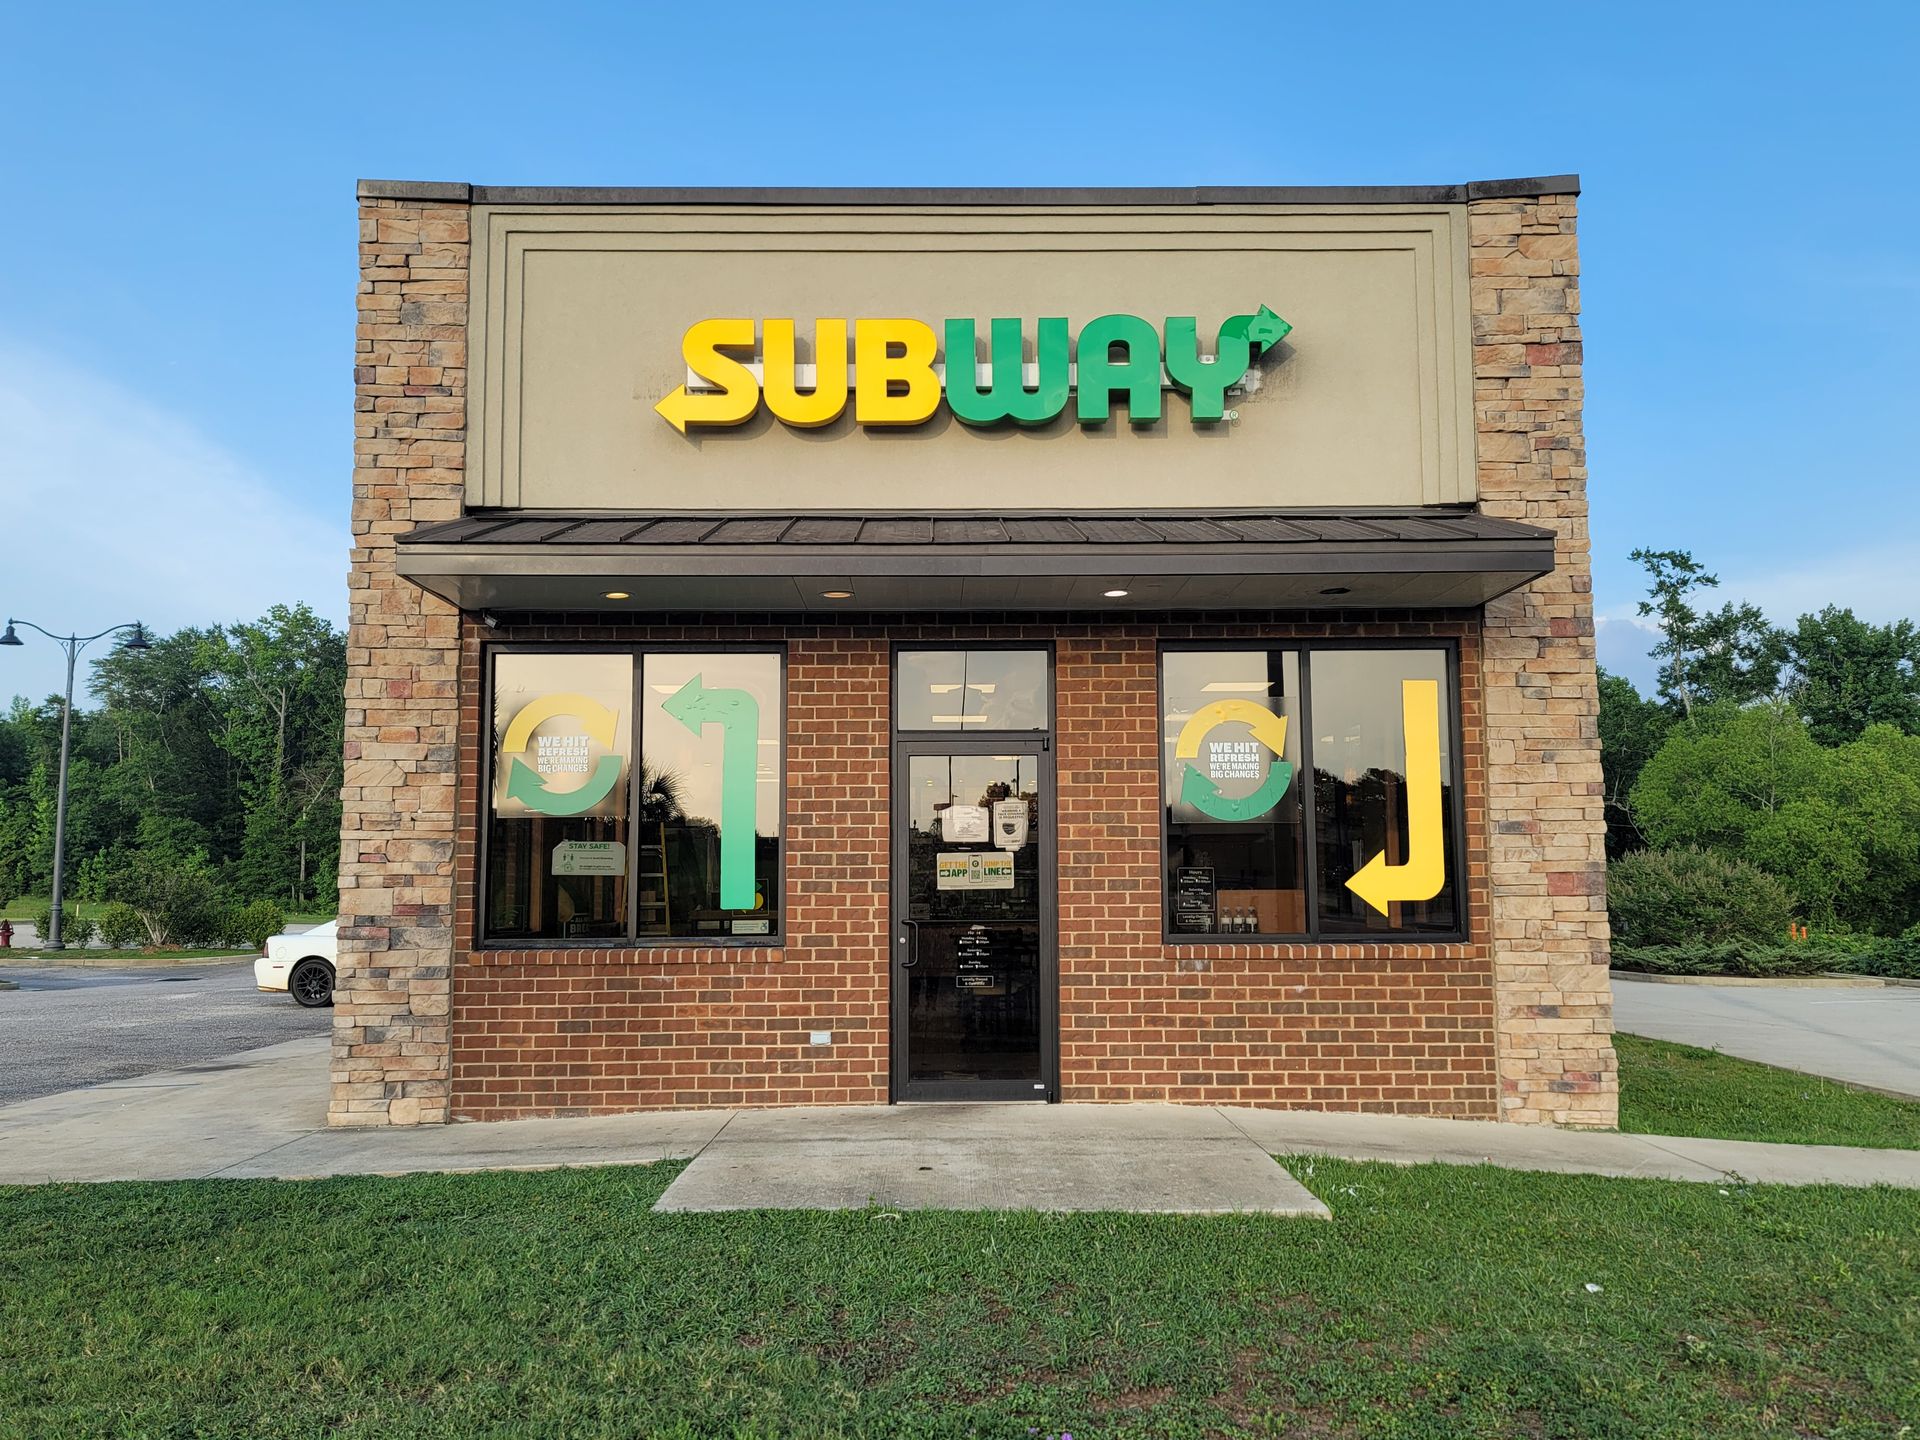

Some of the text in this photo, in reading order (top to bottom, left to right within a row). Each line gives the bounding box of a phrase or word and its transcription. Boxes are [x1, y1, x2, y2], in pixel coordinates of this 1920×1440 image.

[653, 304, 1292, 433] SUBWAY
[537, 736, 589, 747] WE HIT
[538, 747, 589, 756] REFRESH
[1209, 742, 1259, 753] WE HIT
[559, 756, 589, 765] MAKING
[1210, 753, 1260, 762] REFRESH
[537, 764, 589, 773] BIG CHANGES
[1209, 762, 1260, 771] WE'RE MAKING
[1210, 770, 1260, 779] BIG CHANGES
[568, 842, 610, 850] STAY SAFE!
[939, 861, 968, 869] GET THE
[951, 868, 968, 878] APP
[983, 867, 1001, 876] LINE
